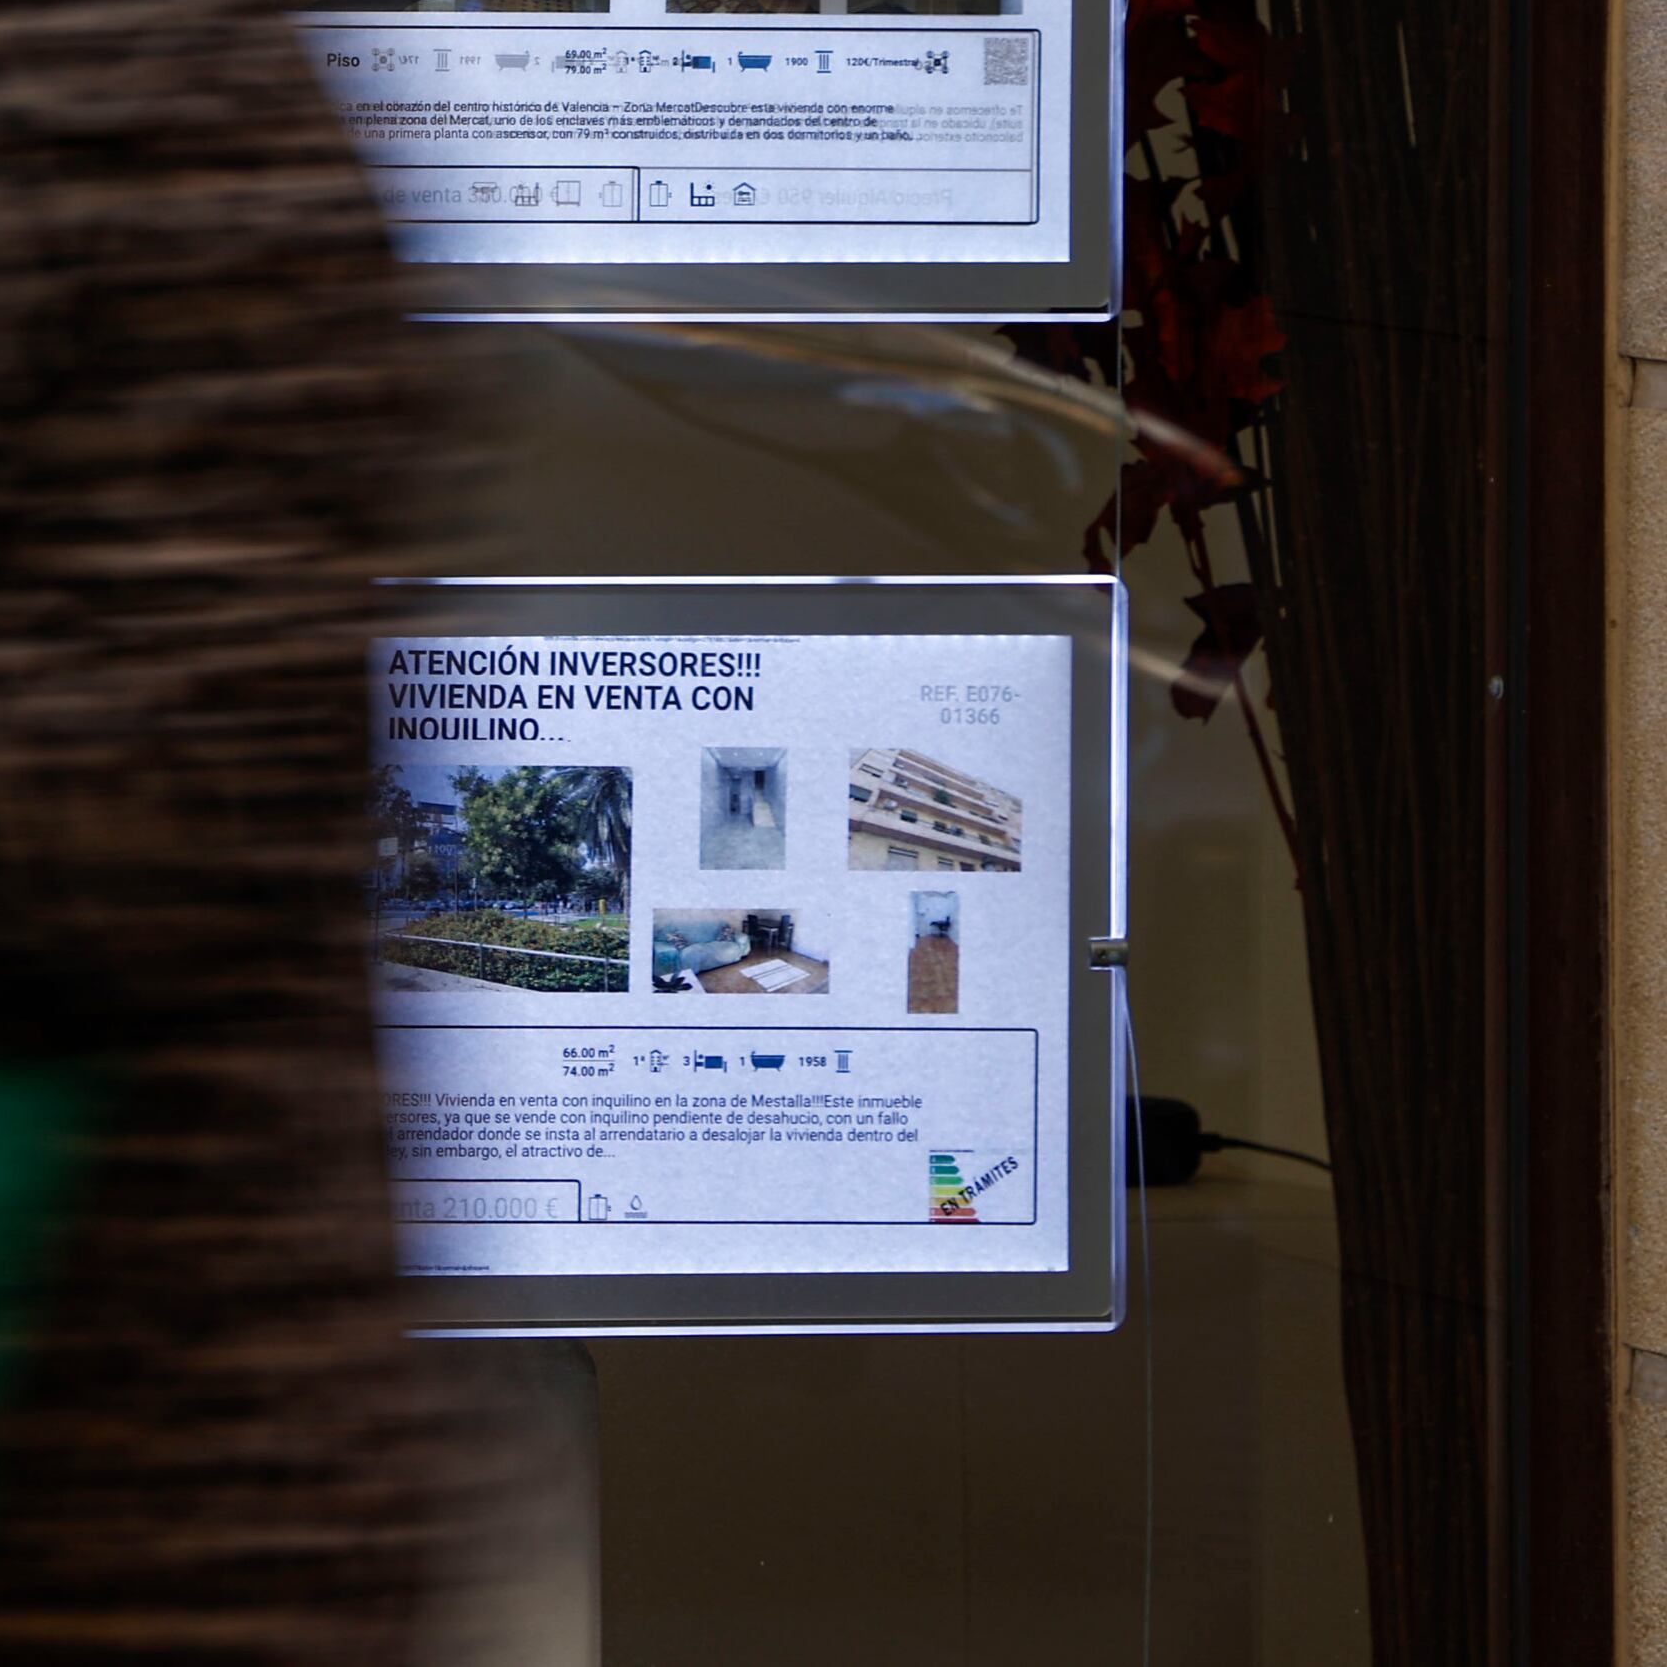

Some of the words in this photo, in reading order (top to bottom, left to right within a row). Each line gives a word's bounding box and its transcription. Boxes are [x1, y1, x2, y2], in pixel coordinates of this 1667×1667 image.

[326, 52, 360, 68] Piso
[388, 644, 540, 678] ATENCIÓN
[550, 651, 761, 678] INVERSORES!!!
[388, 684, 529, 711] VIVIENDA
[537, 684, 575, 710] EN
[584, 684, 683, 711] VENTA
[691, 685, 754, 711] CON
[921, 685, 959, 702] REF.
[966, 685, 1020, 703] E076-
[940, 707, 1001, 726] 01366
[799, 1056, 827, 1067] 1958
